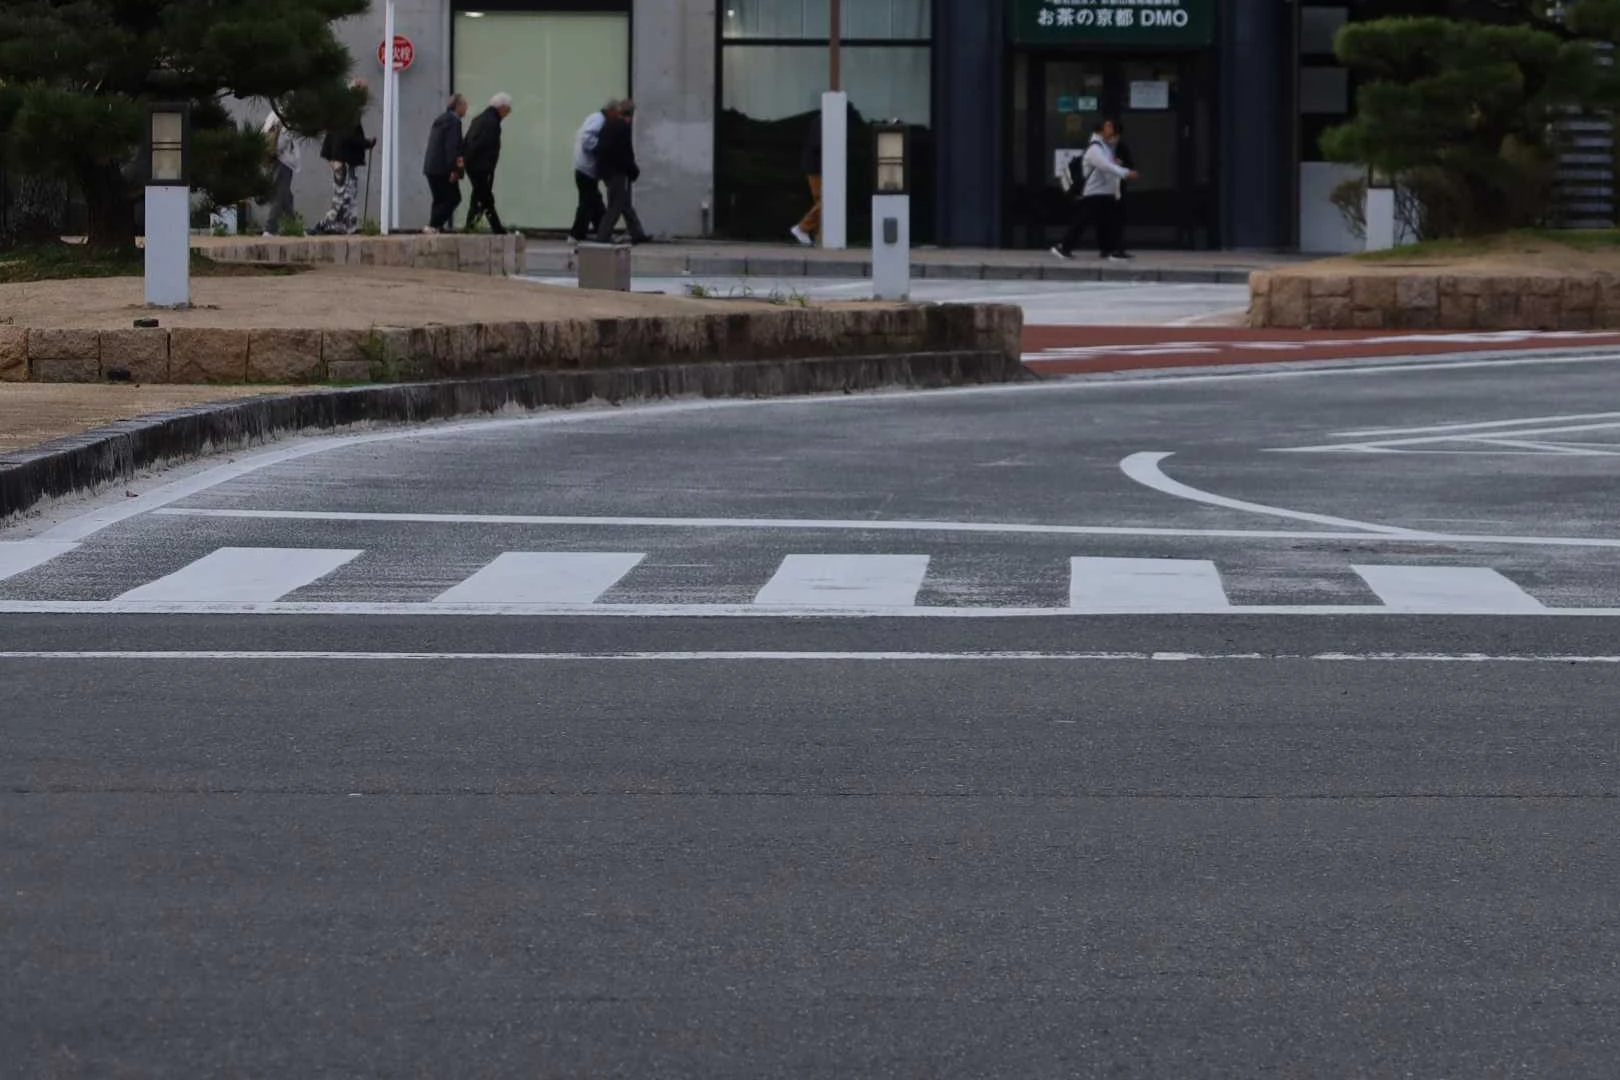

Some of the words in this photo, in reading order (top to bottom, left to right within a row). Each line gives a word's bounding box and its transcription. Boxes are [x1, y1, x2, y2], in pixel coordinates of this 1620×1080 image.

[1037, 7, 1134, 27] お茶の京都
[1140, 8, 1189, 27] DMO
